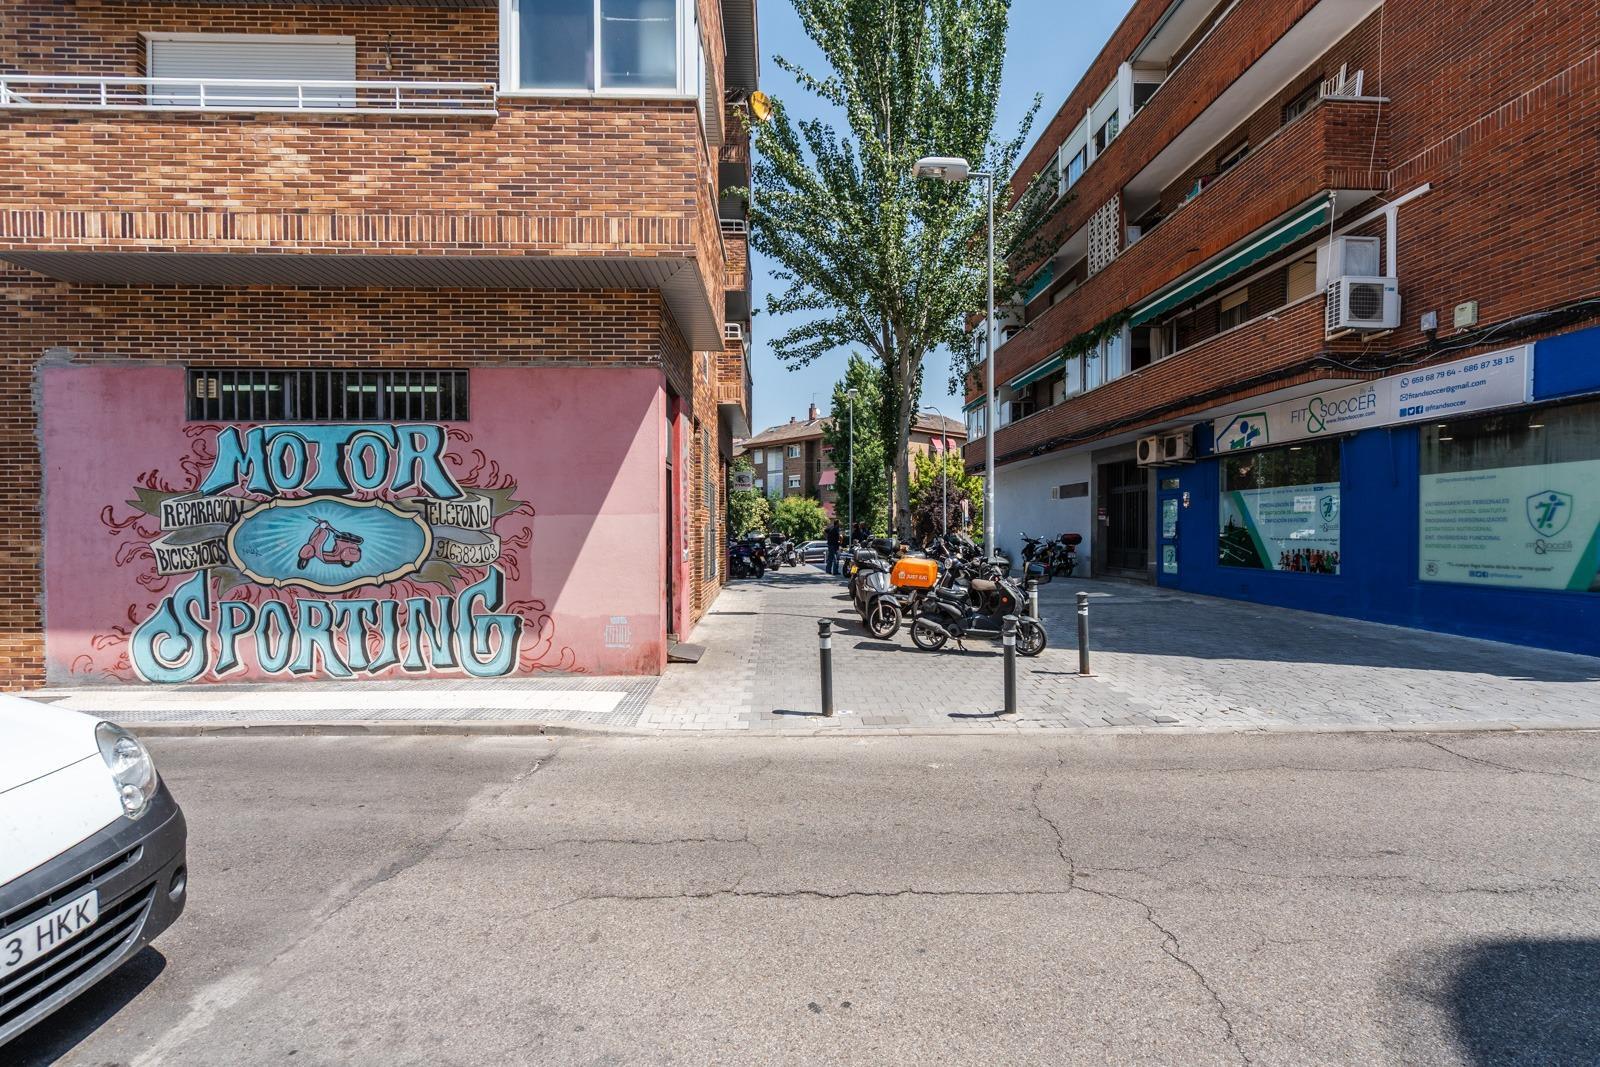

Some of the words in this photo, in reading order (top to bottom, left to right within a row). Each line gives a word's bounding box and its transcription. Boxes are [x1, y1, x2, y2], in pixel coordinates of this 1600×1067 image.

[1425, 374, 1435, 382] 68
[1436, 371, 1445, 379] 79
[1446, 369, 1456, 377] 64
[1463, 364, 1479, 373] 686
[1480, 361, 1491, 369] 87
[1492, 358, 1503, 367] 38
[1505, 355, 1515, 364] 15
[1408, 379, 1487, 400] fitandsoccer@gmail.com
[1291, 408, 1308, 424] FIT
[1320, 393, 1376, 418] SOCCER
[199, 424, 465, 499] MOTOR
[156, 547, 193, 571] BICIS
[191, 539, 228, 568] MOTOS
[435, 540, 498, 564] 916382103
[129, 565, 523, 684] SPORTING
[0, 938, 23, 970] 3
[36, 898, 91, 951] HKK
